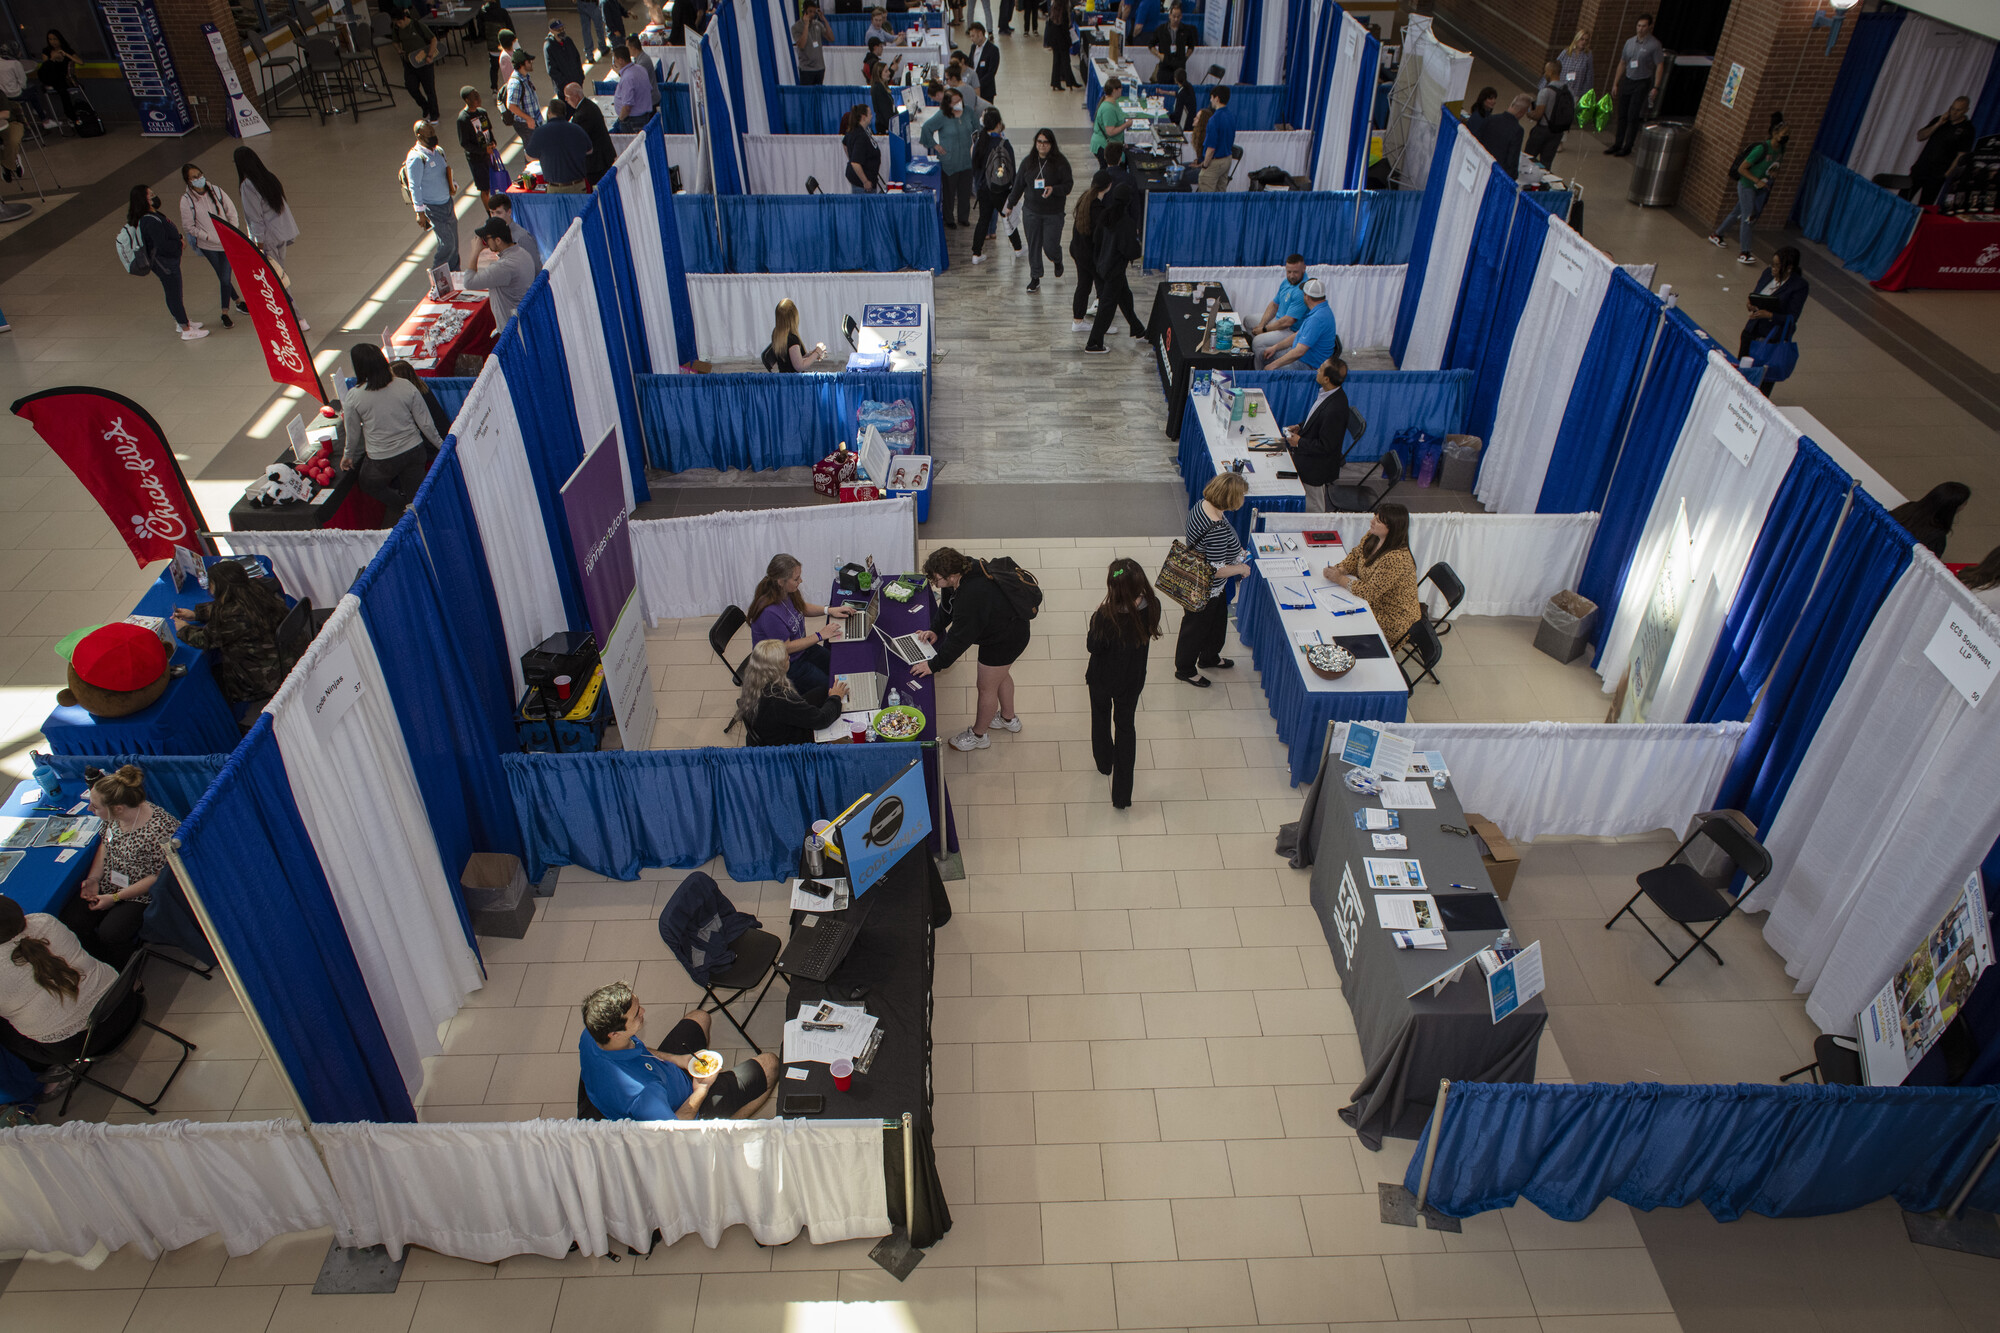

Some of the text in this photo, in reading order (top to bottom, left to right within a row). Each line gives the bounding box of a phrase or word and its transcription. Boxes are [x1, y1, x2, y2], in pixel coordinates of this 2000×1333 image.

[145, 8, 190, 126] FIND YOUR FUTURE
[1938, 266, 2000, 274] MARINES.
[254, 267, 304, 373] Chick-fil-A
[103, 416, 187, 541] Chick-fil-A
[1949, 621, 1992, 670] ECS Southwest,
[1958, 646, 1972, 660] LLP
[316, 675, 344, 714] Code Ninjas
[353, 681, 362, 693] 37
[1971, 691, 1980, 702] 50
[858, 818, 924, 885] CODE NINJAS
[1876, 996, 1885, 1018] YOUR
[1881, 992, 1889, 1009] YOU
[1888, 997, 1898, 1035] EMPOWER
